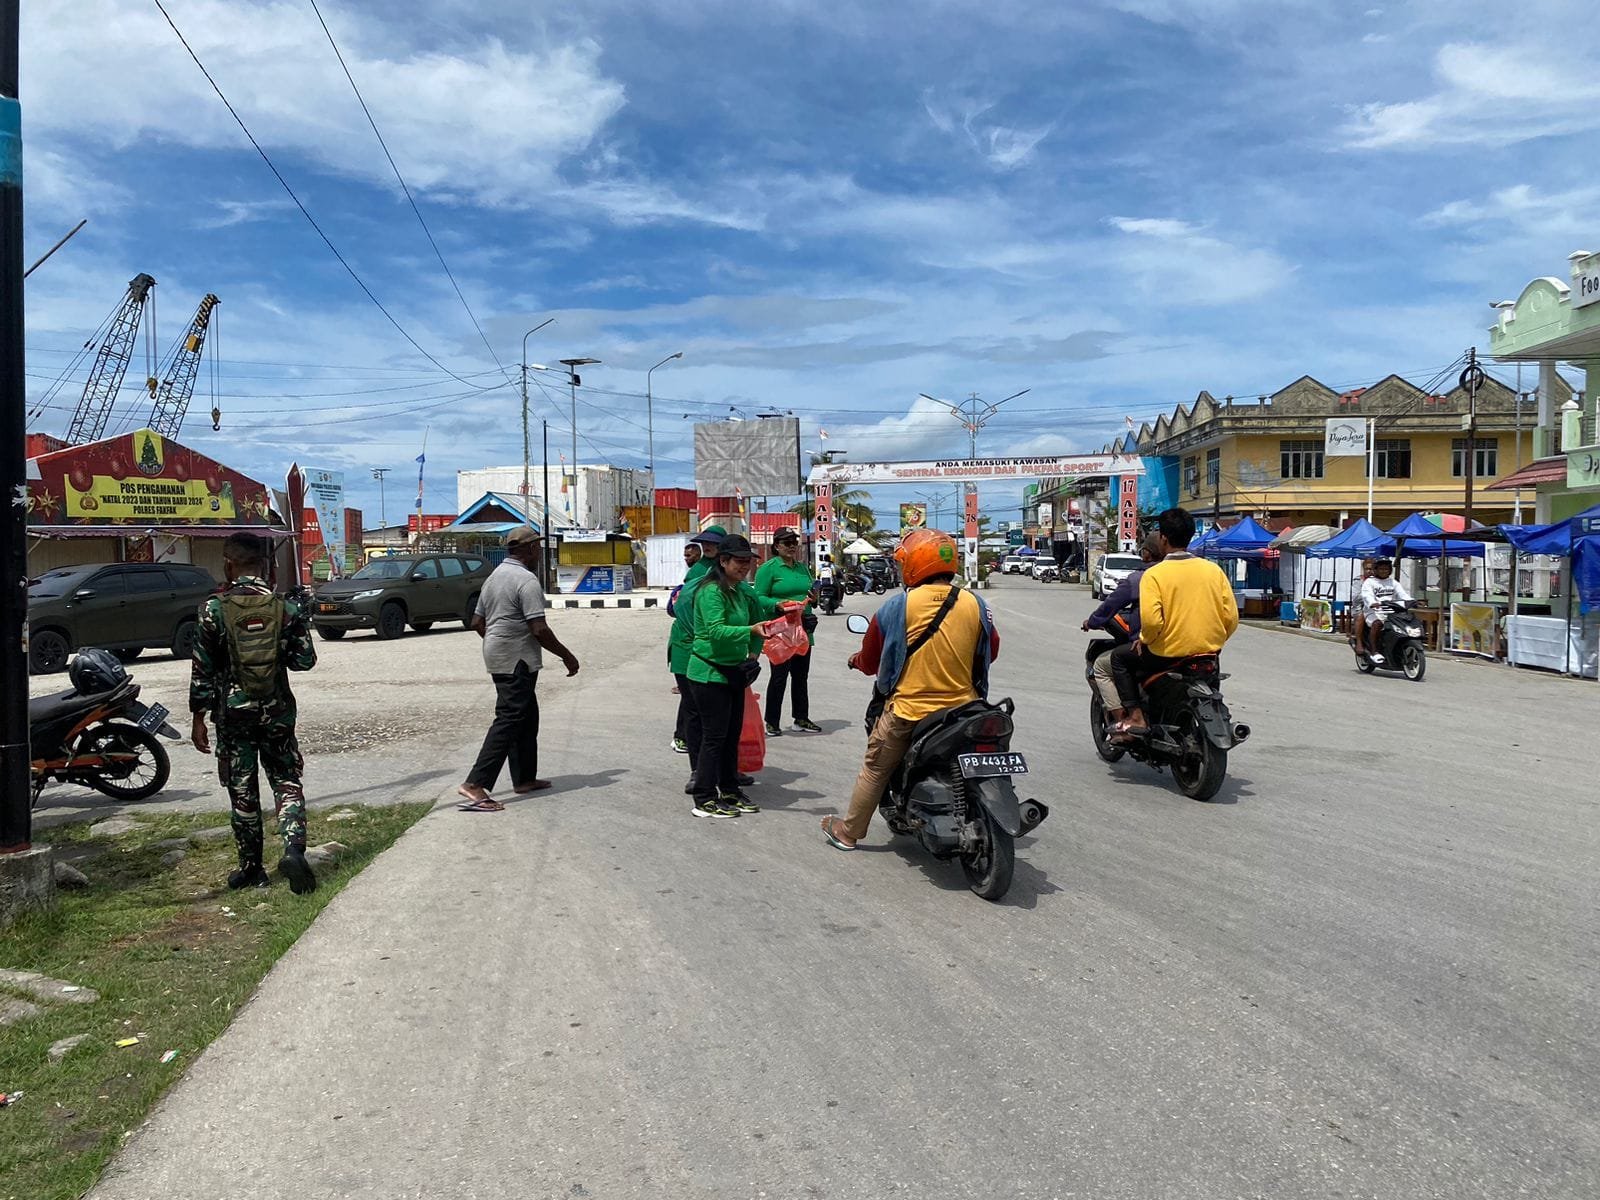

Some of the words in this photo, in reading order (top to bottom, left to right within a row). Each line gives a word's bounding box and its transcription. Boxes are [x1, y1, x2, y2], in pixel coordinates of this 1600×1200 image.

[962, 459, 1010, 467] MEMASUKI
[1013, 457, 1058, 465] KAWASAN
[994, 466, 1017, 475] DAN
[120, 482, 136, 494] POS
[137, 483, 185, 495] PENGAMANAN
[815, 485, 828, 497] 17
[1122, 480, 1135, 493] 17
[121, 495, 138, 505] 2023
[139, 496, 152, 505] DAN
[152, 496, 171, 505] TAHUN
[172, 496, 188, 505] BARU
[133, 505, 155, 514] POLRES
[156, 505, 177, 515] FAKFAK
[965, 513, 977, 523] 78
[963, 757, 979, 767] PB
[982, 755, 1007, 766] 4432
[1008, 755, 1022, 765] FA
